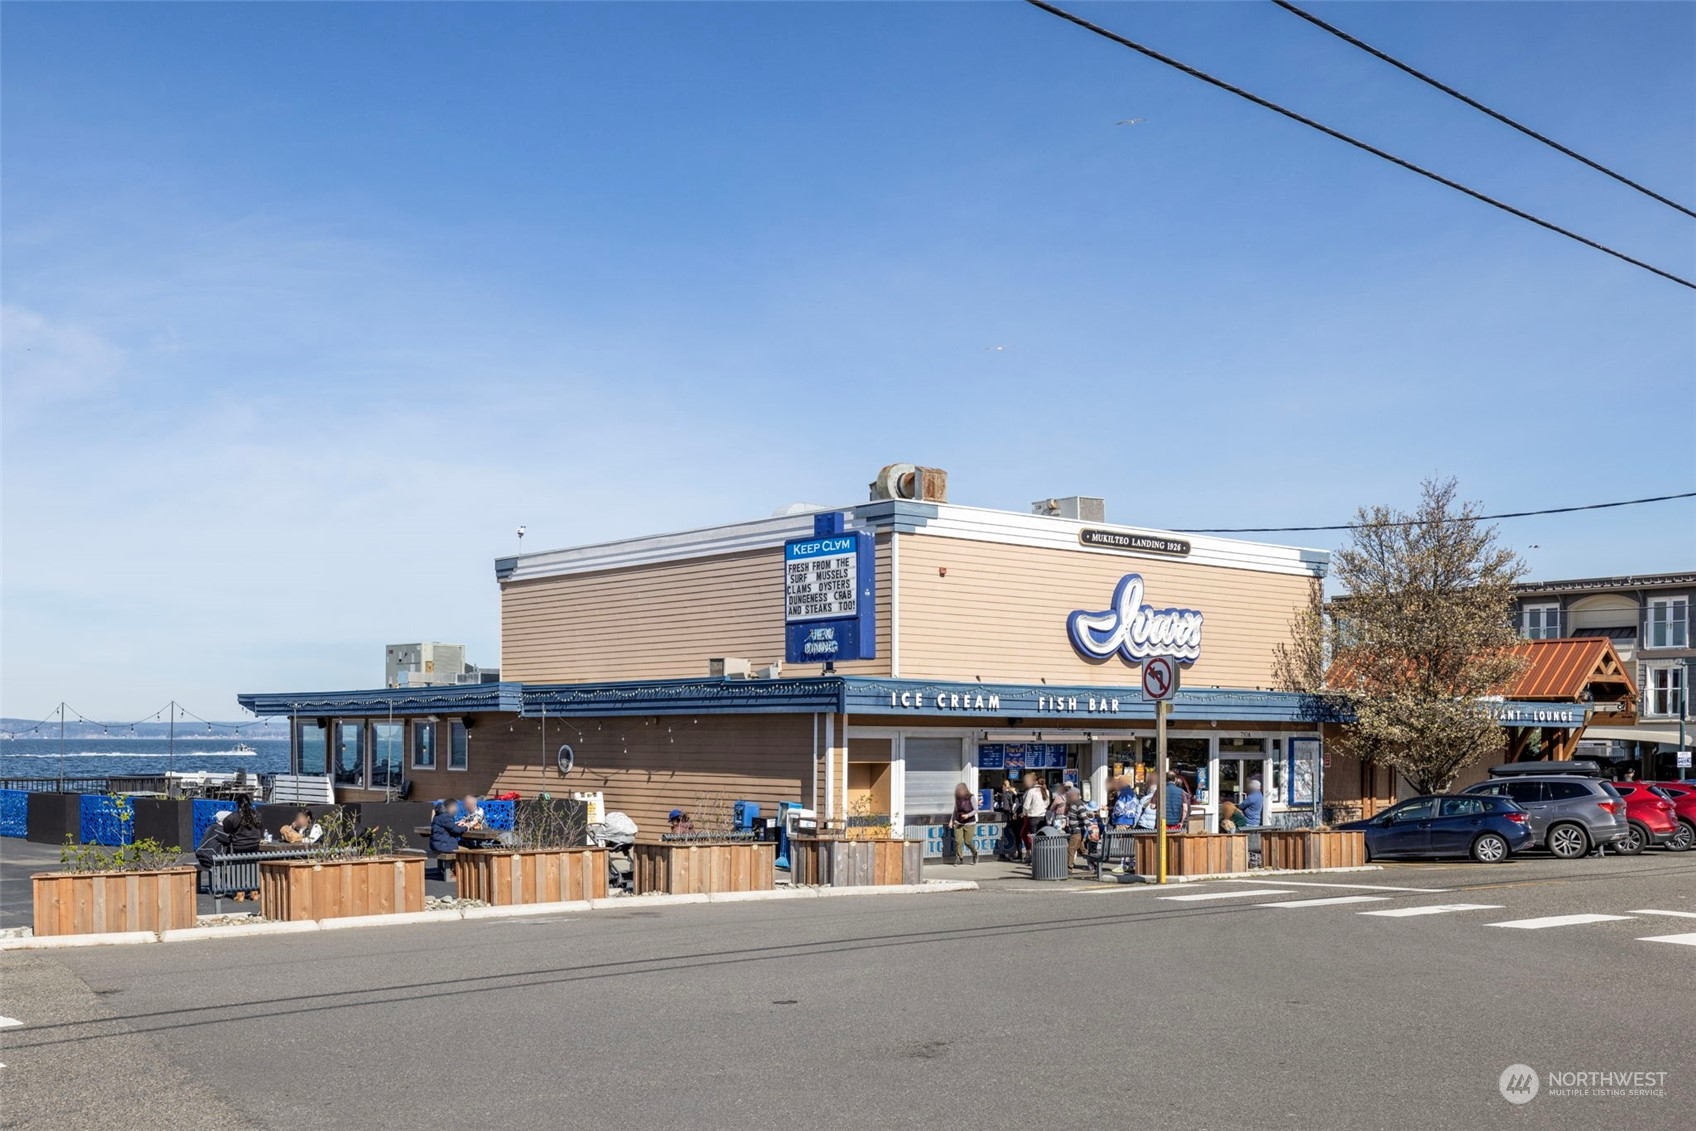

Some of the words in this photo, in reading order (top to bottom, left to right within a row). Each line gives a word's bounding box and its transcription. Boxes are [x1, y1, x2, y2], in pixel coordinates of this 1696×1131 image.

[793, 543, 820, 556] KEEP
[822, 539, 850, 552] CLAM
[1091, 533, 1129, 545] MUKILTEO
[1131, 538, 1165, 549] LANDING
[1166, 542, 1182, 551] 1926
[788, 562, 809, 574] FRESH
[812, 560, 831, 571] FROM
[836, 557, 850, 568] THE
[790, 573, 807, 584] SURF
[816, 568, 849, 581] MUSSELS
[787, 583, 812, 595] CLAMS
[818, 579, 851, 592] OYSTERS
[788, 592, 828, 605] DUNGENESS
[833, 590, 852, 601] CRAB
[788, 605, 802, 616] AND
[805, 603, 832, 614] STEAKS
[838, 600, 856, 611] TOO!
[891, 692, 923, 707] ICE
[937, 693, 1000, 709] CREAM
[1039, 696, 1077, 711] FISH
[1088, 698, 1119, 712] BAR
[1533, 711, 1573, 721] LOUNGE
